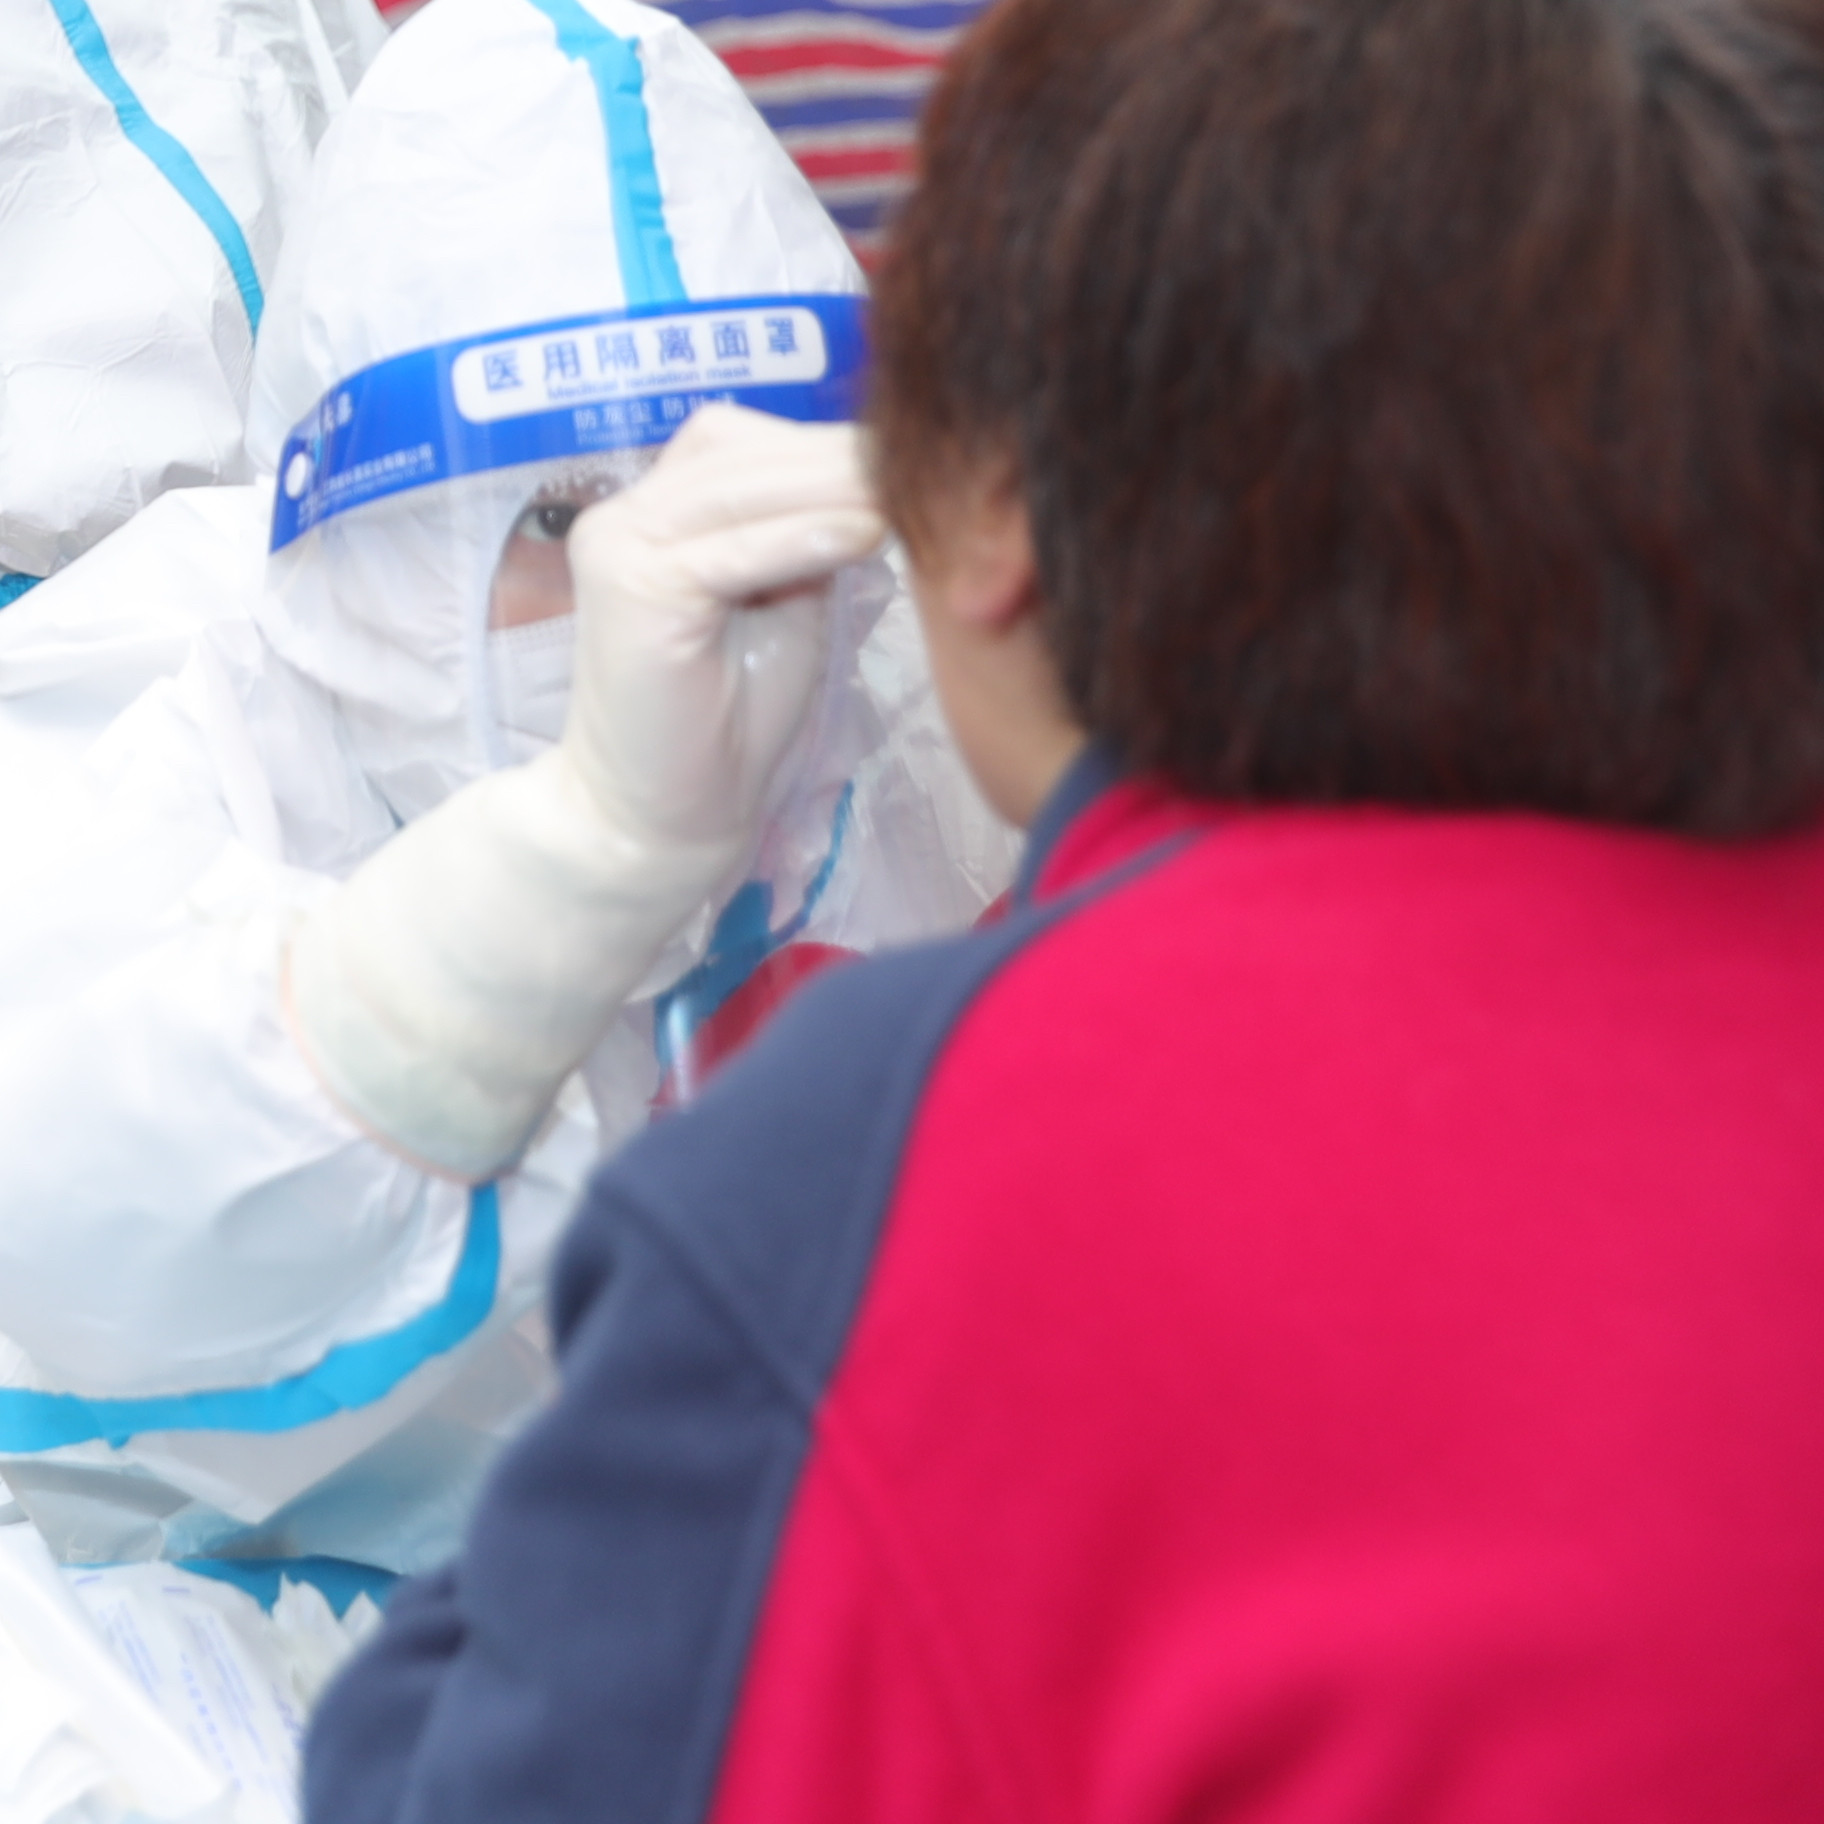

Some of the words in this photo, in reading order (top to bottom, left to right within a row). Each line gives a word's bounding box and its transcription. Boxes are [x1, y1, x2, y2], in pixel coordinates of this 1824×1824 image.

[483, 315, 799, 392] 医用隔离面罩
